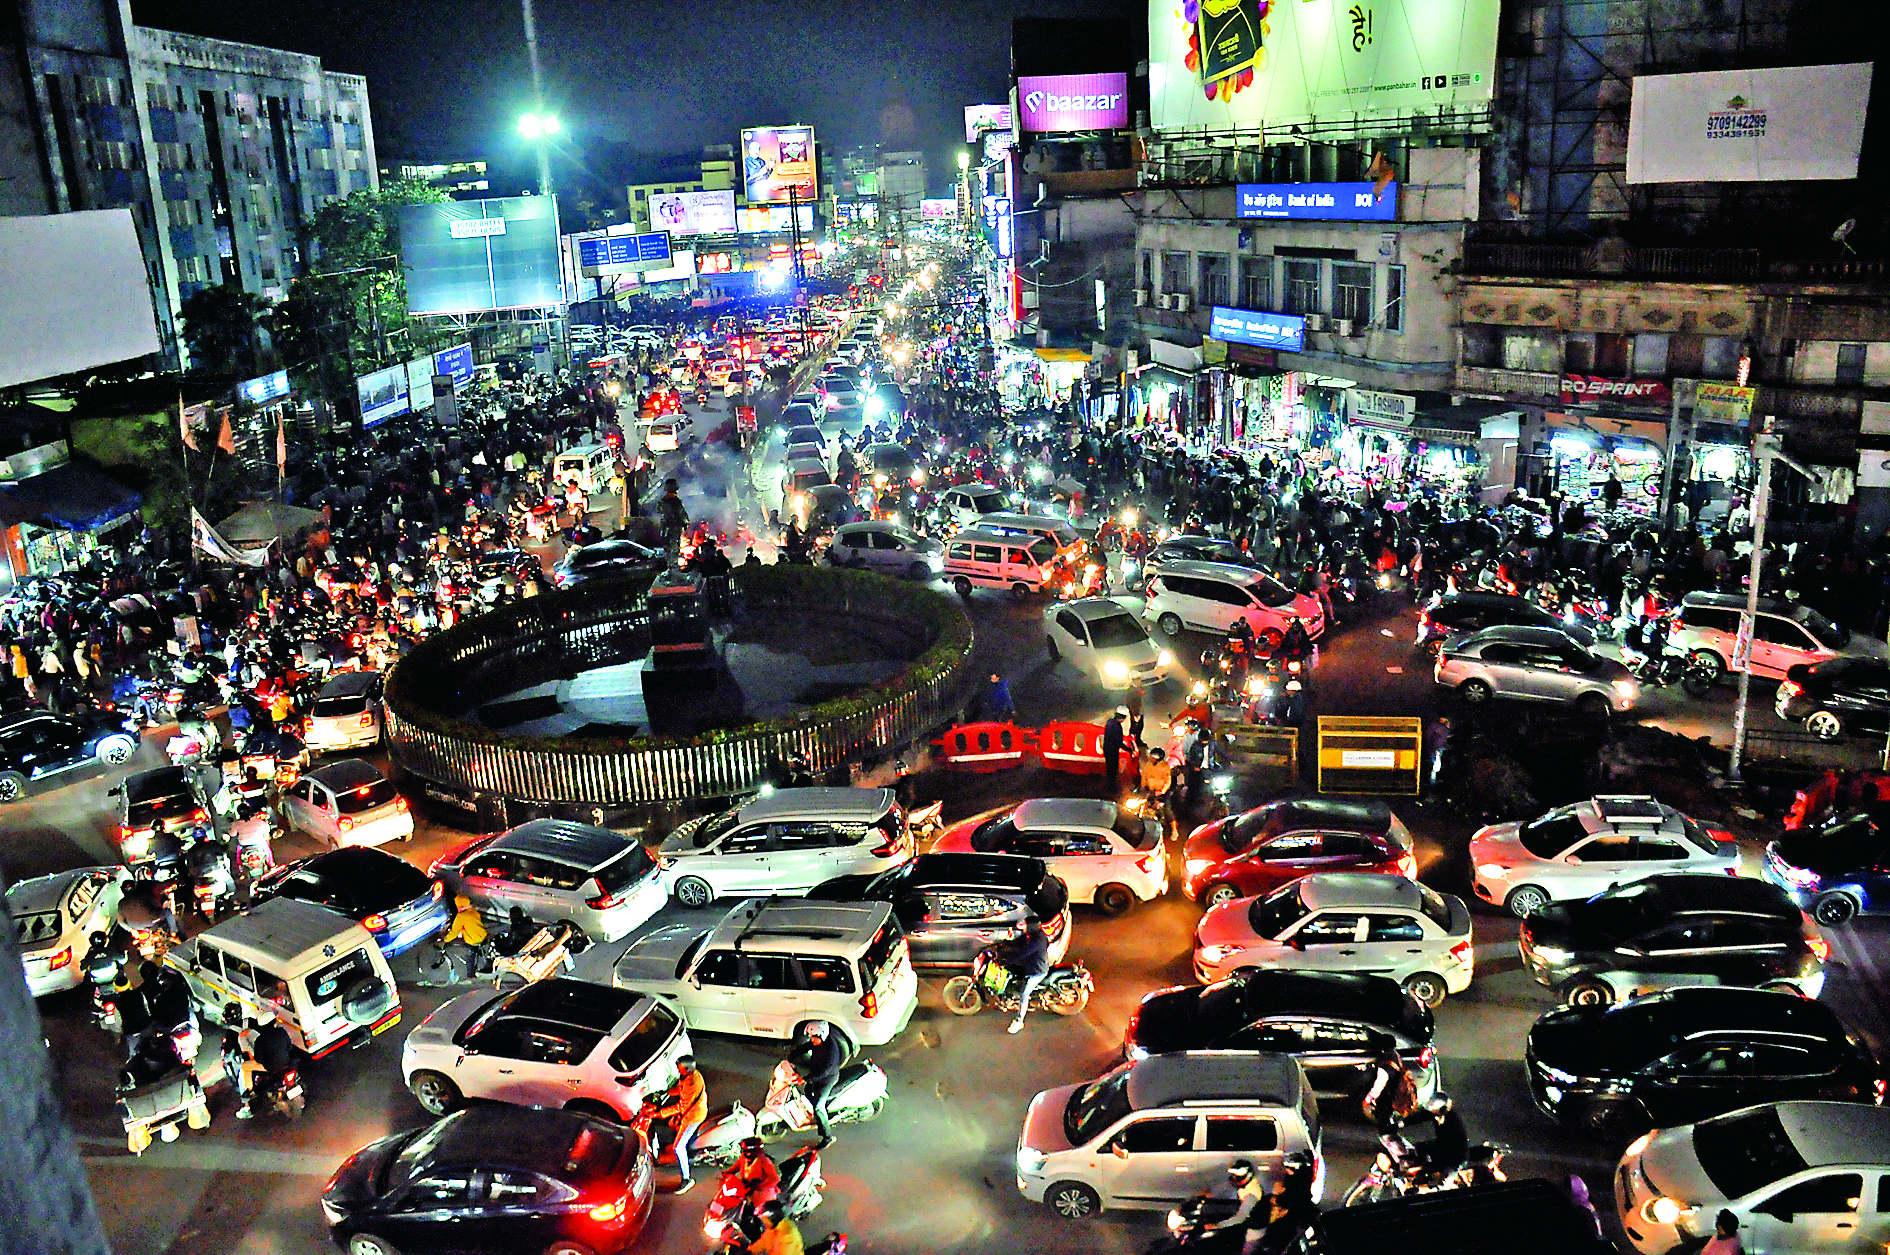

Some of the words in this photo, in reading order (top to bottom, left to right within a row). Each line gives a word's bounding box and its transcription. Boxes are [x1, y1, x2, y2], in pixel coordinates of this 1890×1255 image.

[1374, 81, 1417, 92] www.panbahar.in
[1046, 92, 1121, 112] baazar
[1707, 114, 1767, 131] 9709142299
[1287, 193, 1307, 207] Bank
[1354, 193, 1373, 208] BOI
[1561, 379, 1587, 394] RO
[1586, 381, 1658, 396] SPRINT
[319, 960, 356, 985] AMBULANCE
